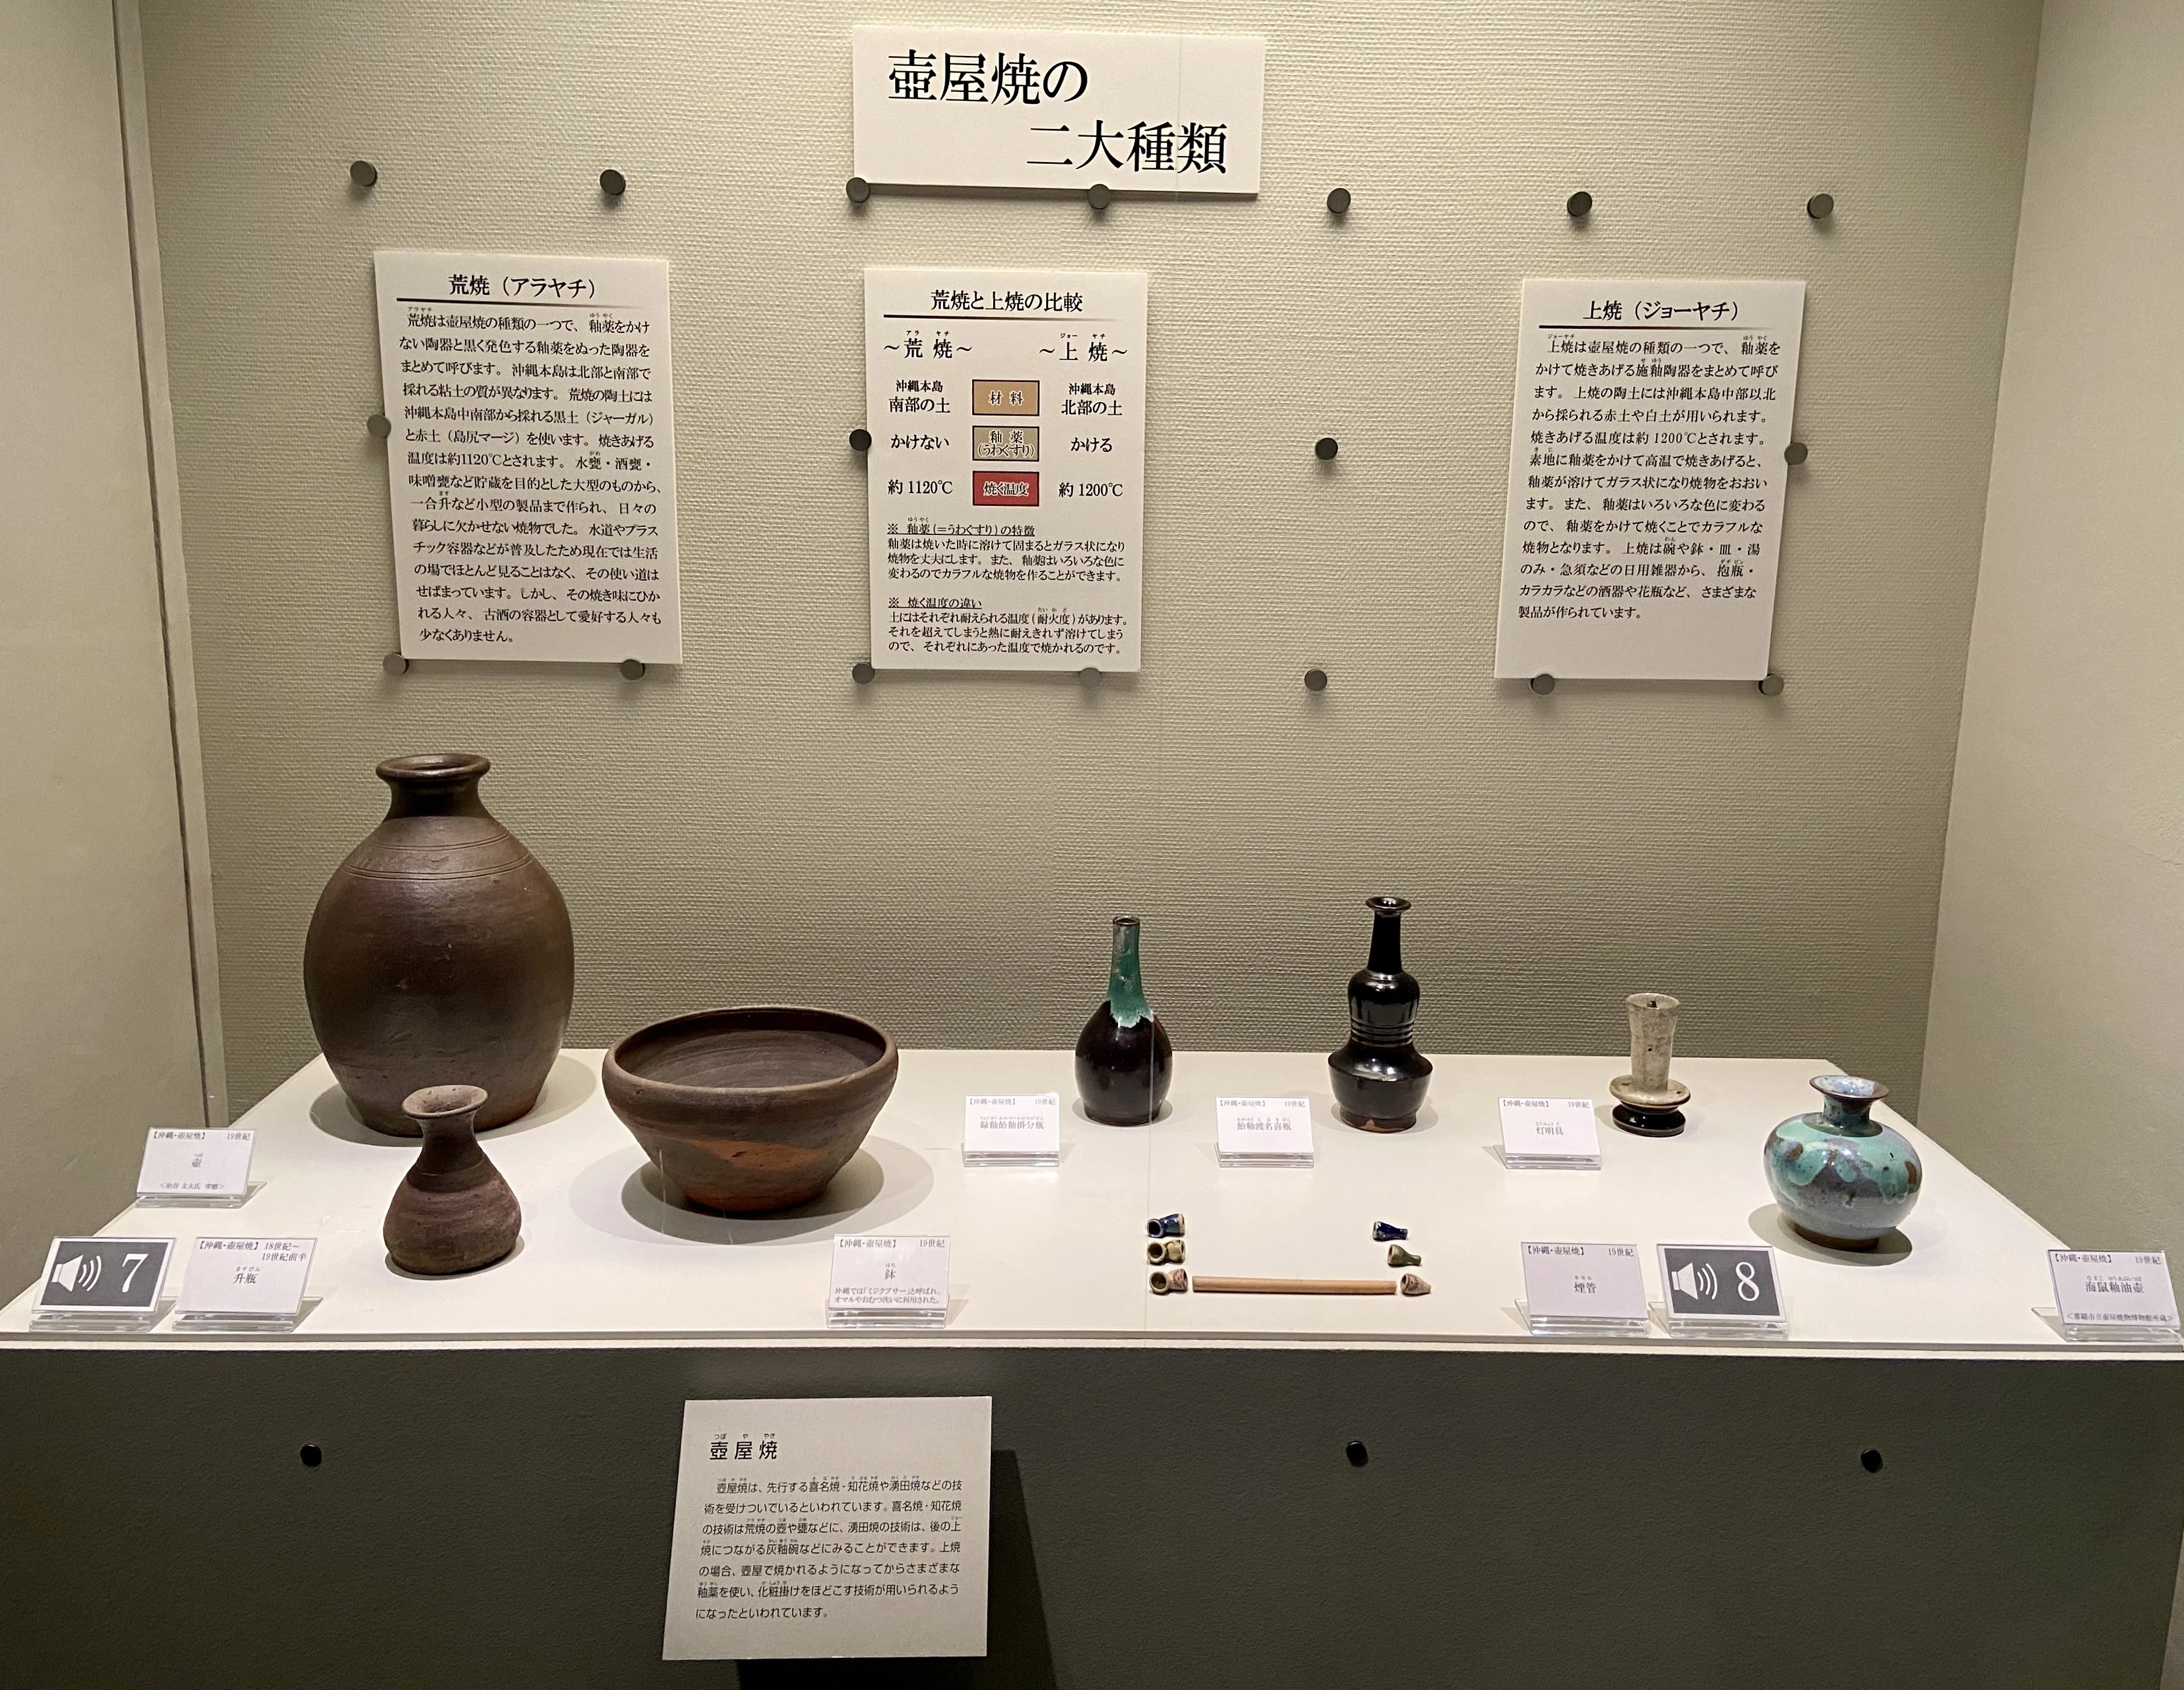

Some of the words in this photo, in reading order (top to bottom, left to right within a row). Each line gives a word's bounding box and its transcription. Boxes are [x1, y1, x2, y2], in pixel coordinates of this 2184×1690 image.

[888, 49, 1088, 105] 壺屋焼の
[1027, 120, 1228, 174] 二大種類
[449, 274, 596, 299] 荒焼（アラヤチ）
[931, 290, 1083, 312] 荒焼と上焼の比較
[1584, 301, 1738, 321] 上焼（ジョーヤチ）
[400, 337, 649, 357] ない陶器と黒く発色する釉薬をぬった陶器を
[1536, 363, 1778, 378] かけて焼きあげる施釉陶器をまとめて呼び
[896, 380, 943, 392] 沖縄本島
[1068, 383, 1116, 395] 沖縄本島
[889, 397, 951, 413] 南部の土
[1061, 400, 1122, 416] 北部の土
[1532, 409, 1766, 423] から採られる赤土や白土が用いられます。
[891, 435, 949, 449] かけない
[1071, 438, 1112, 453] かける
[979, 444, 1034, 457] (うわぐすり)
[1529, 453, 1761, 468] 素地に釉薬をかけて高温で焼きあげると、
[983, 482, 1029, 497] 焼く温度
[1528, 476, 1767, 490] 釉薬が溶けてガラス状になり焼物をおおい
[414, 541, 657, 559] チック容器などが普及したため現在では生活
[888, 568, 1121, 582] 変わるのでカラフルな焼物を作ることができます。
[1518, 606, 1641, 619] 製品が作られています。
[420, 630, 514, 642] 少なくありません。
[889, 626, 1123, 640] それを超えてしまうと熱に耐えきれず溶けてしまう
[920, 1240, 945, 1248] 19世紀
[262, 1253, 307, 1261] 19世紀前半
[1609, 1248, 1634, 1256] 19世紀
[121, 1253, 148, 1293] 7
[233, 1273, 258, 1284] 升瓶
[884, 1269, 895, 1280] 鉢
[1574, 1282, 1596, 1293] 煙管
[1735, 1261, 1760, 1301] 8
[709, 1441, 778, 1460] 壺屋焼
[696, 1606, 828, 1619] になったといわれています。
